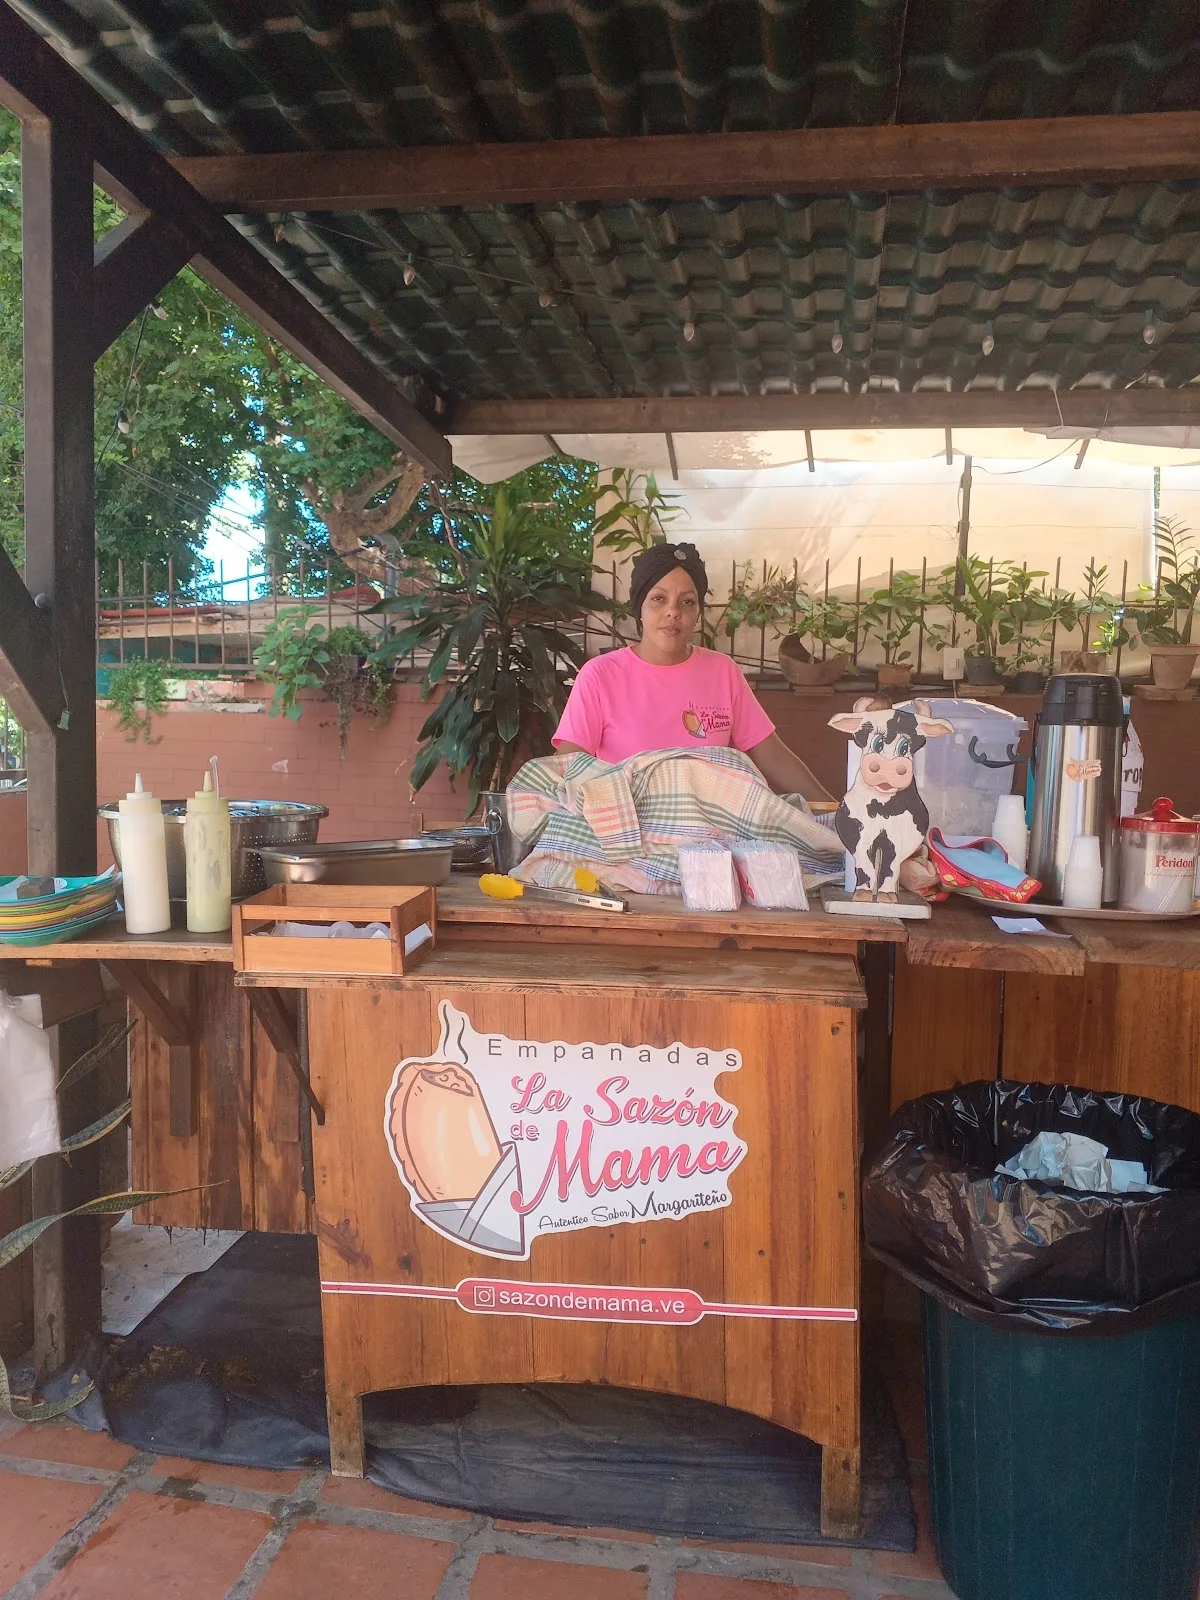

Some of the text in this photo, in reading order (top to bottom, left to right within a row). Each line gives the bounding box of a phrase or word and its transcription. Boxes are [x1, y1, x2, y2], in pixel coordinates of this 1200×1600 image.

[488, 1038, 738, 1067] Empanadas
[510, 1071, 733, 1129] La Sazón
[510, 1119, 743, 1217] de Mama
[537, 1189, 728, 1230] Autentico Sabor Margariteño
[499, 1290, 685, 1314] sazondemama.ve
